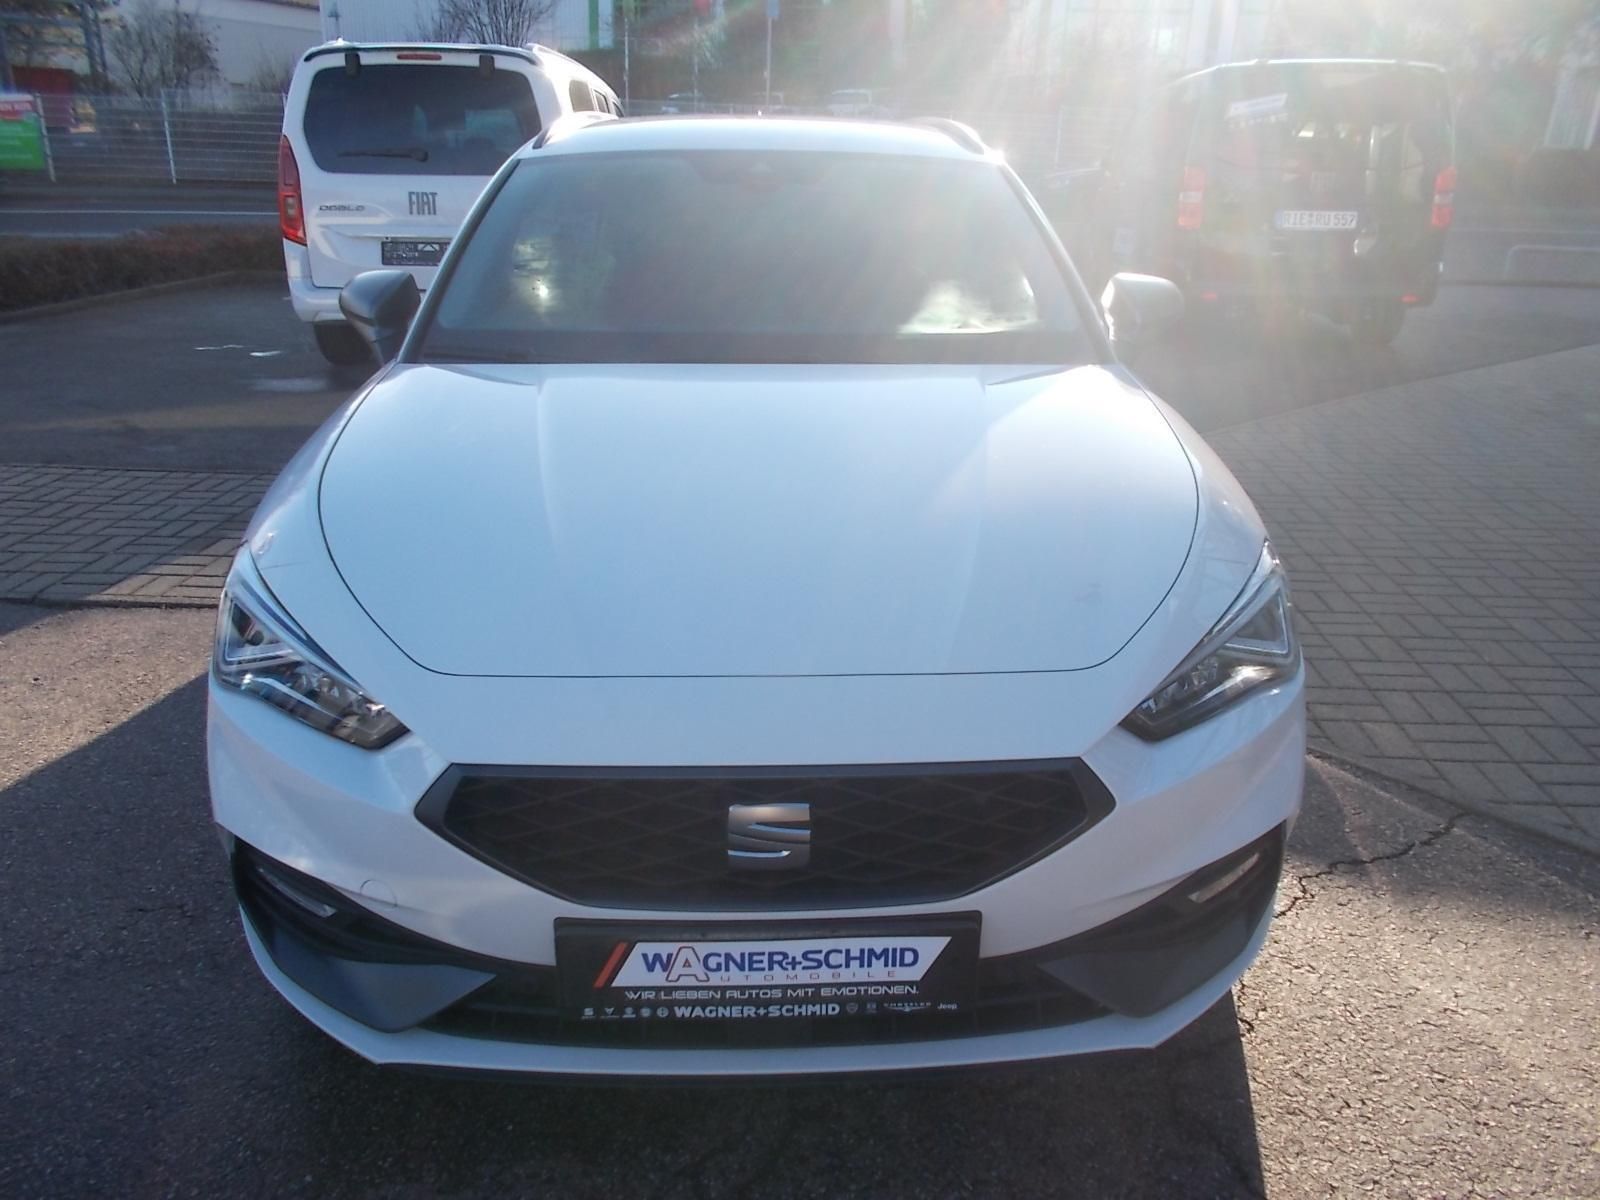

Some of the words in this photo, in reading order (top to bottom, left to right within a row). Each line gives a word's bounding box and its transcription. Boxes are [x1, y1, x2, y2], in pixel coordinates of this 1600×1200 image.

[408, 191, 438, 215] FIAT
[1334, 212, 1356, 227] 557
[641, 946, 920, 982] WAGNER+SCHMID
[625, 990, 656, 1000] WIR
[661, 990, 721, 999] LIEBEN
[726, 987, 783, 999] AUTOS
[787, 987, 815, 997] MIT
[673, 1003, 840, 1018] WAGNER+SCHMID
